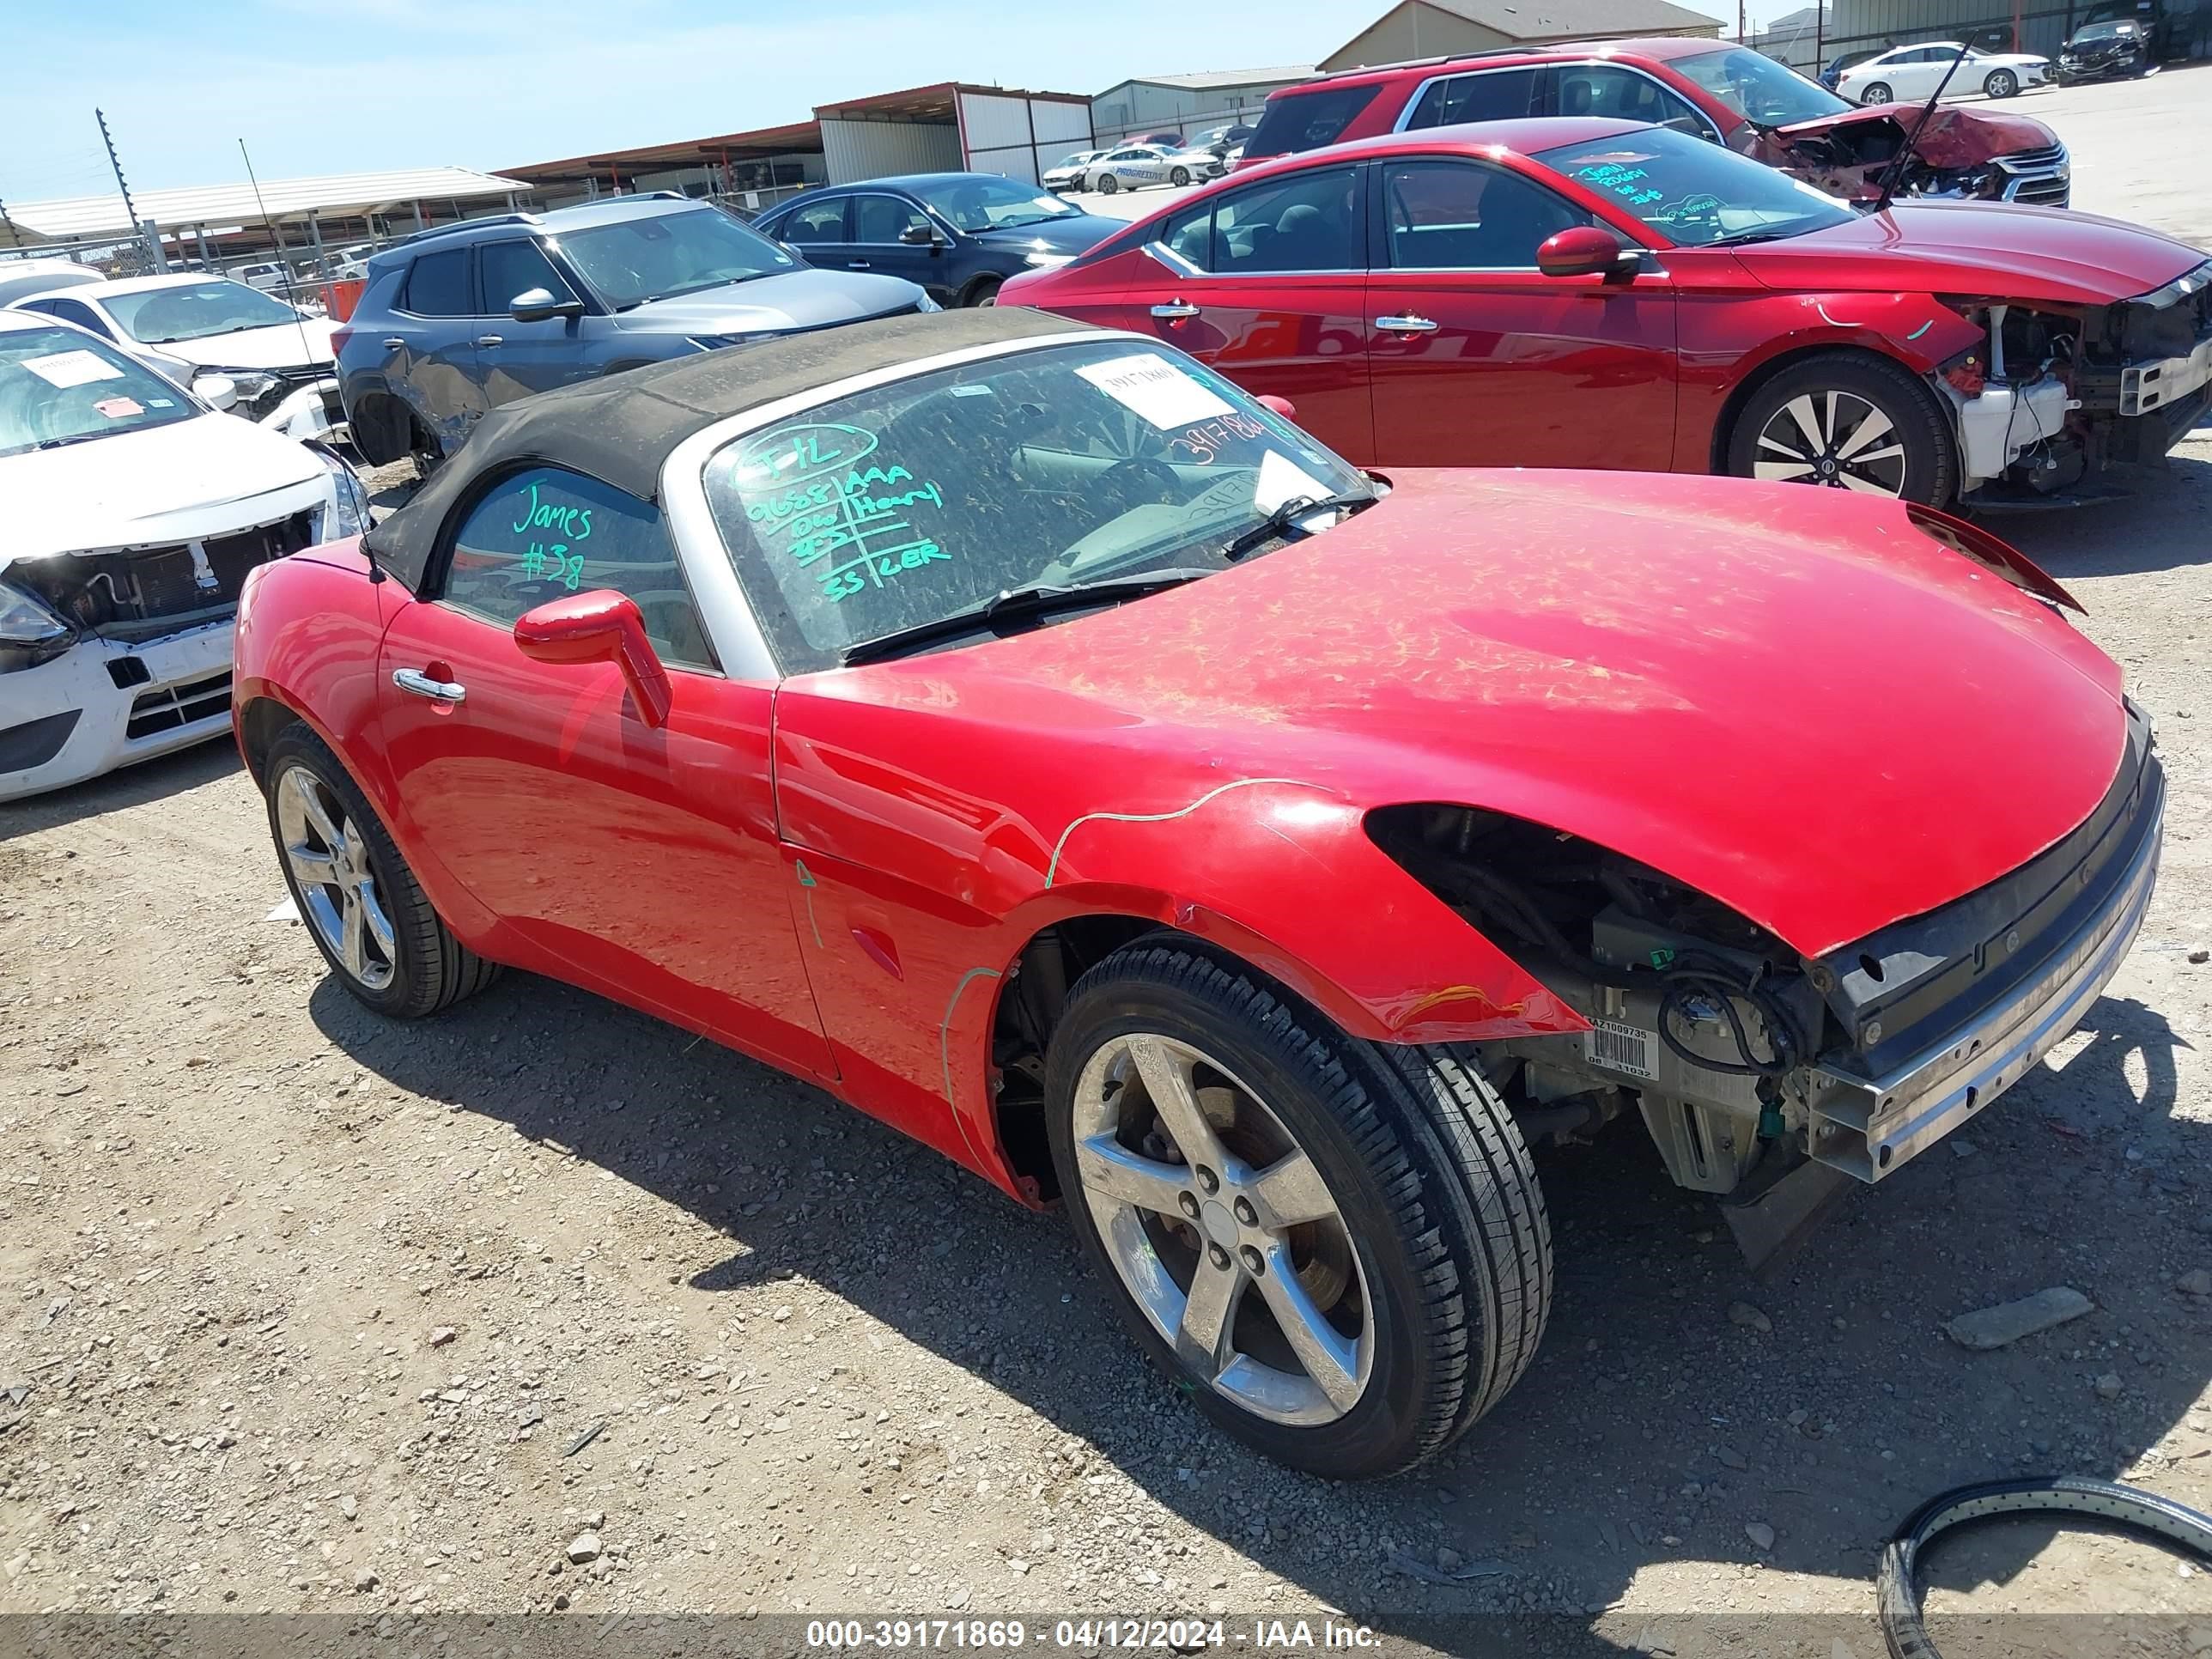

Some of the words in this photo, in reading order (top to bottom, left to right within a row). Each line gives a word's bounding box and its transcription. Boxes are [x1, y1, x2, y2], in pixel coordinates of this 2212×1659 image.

[1115, 167, 1164, 180] PROGRESSIVE
[844, 465, 914, 494] AAA
[514, 477, 592, 541] James
[521, 542, 585, 591] #38
